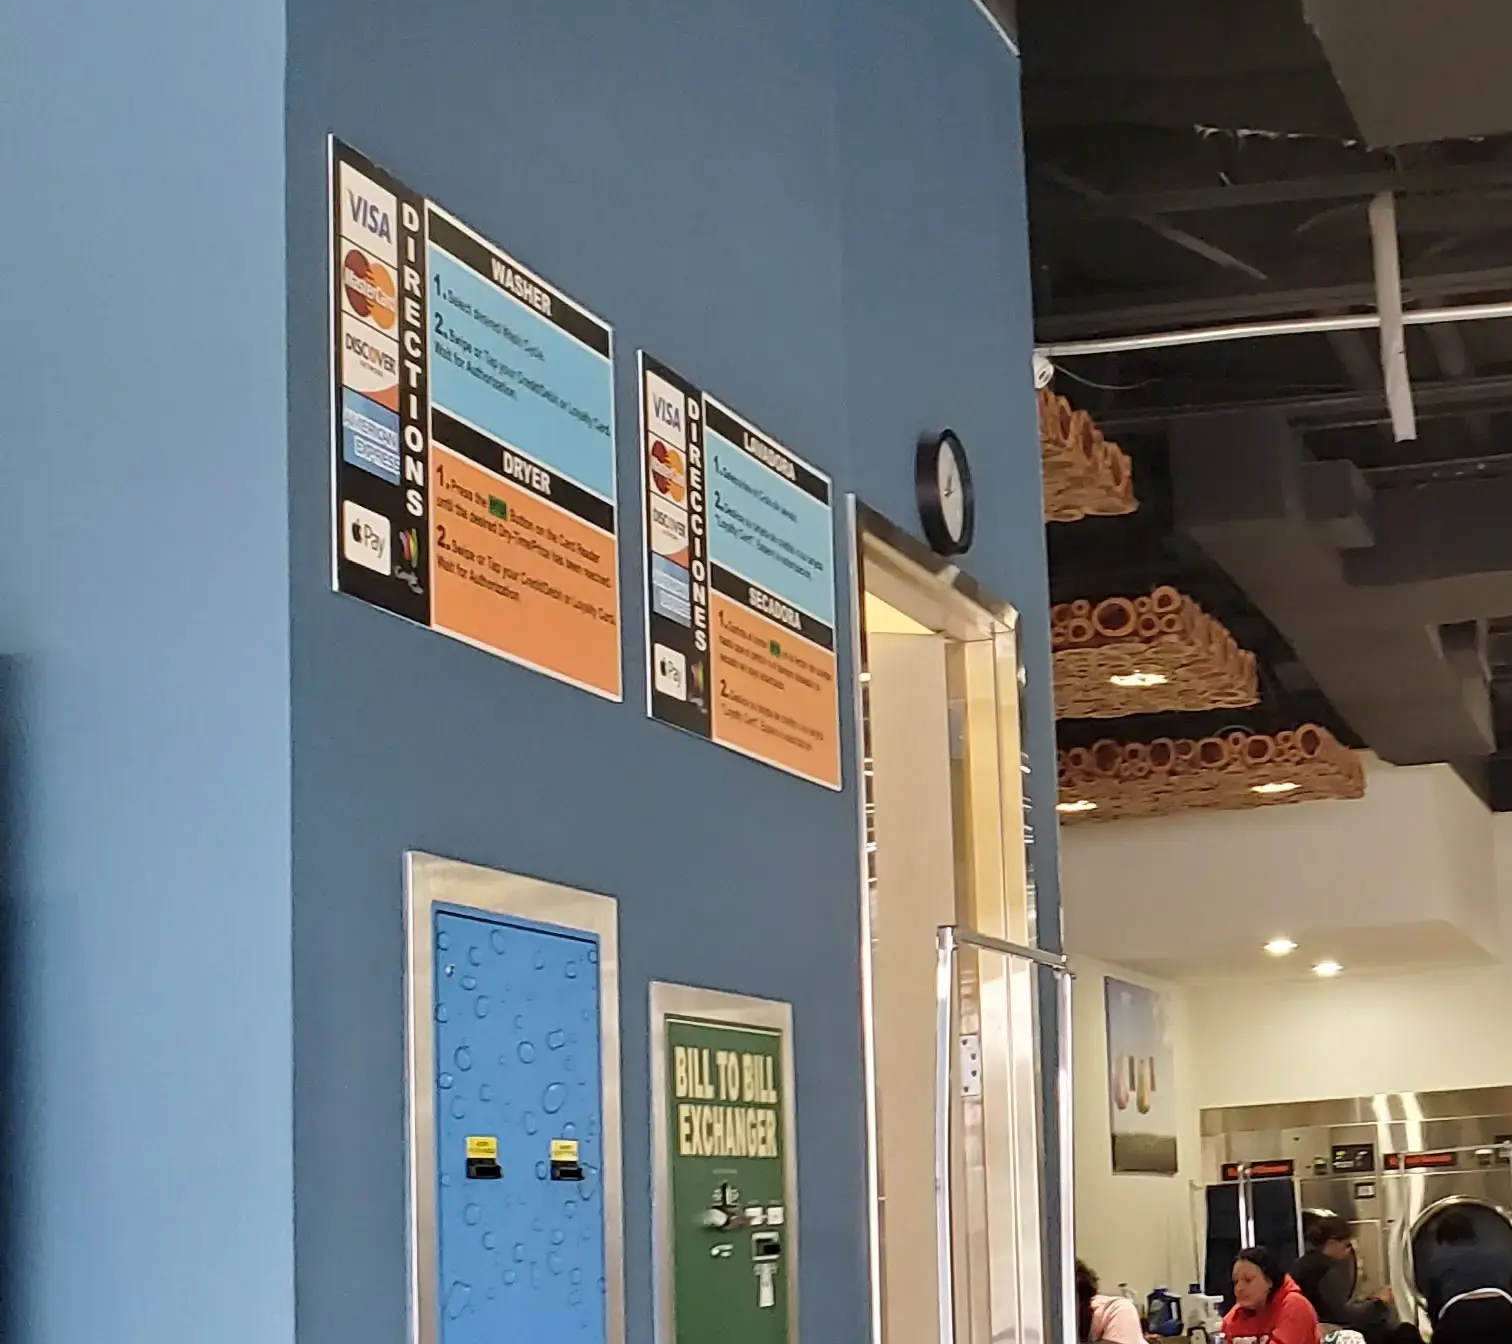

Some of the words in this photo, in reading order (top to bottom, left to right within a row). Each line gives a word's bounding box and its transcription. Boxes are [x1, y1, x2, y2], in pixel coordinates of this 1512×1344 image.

[347, 188, 392, 245] VISA
[491, 257, 552, 317] WASHER
[345, 332, 397, 376] DISCOVER
[401, 201, 425, 517] DIRECTIONS
[652, 393, 682, 433] VISA
[502, 450, 552, 495] DRYER
[363, 522, 386, 559] Pay
[687, 396, 708, 652] DIRECCIONES
[748, 586, 803, 632] SECADORA
[673, 1045, 715, 1099] BILL
[715, 1049, 740, 1102] TO
[741, 1052, 778, 1105] BILL
[677, 1102, 779, 1158] EXCHANGER
